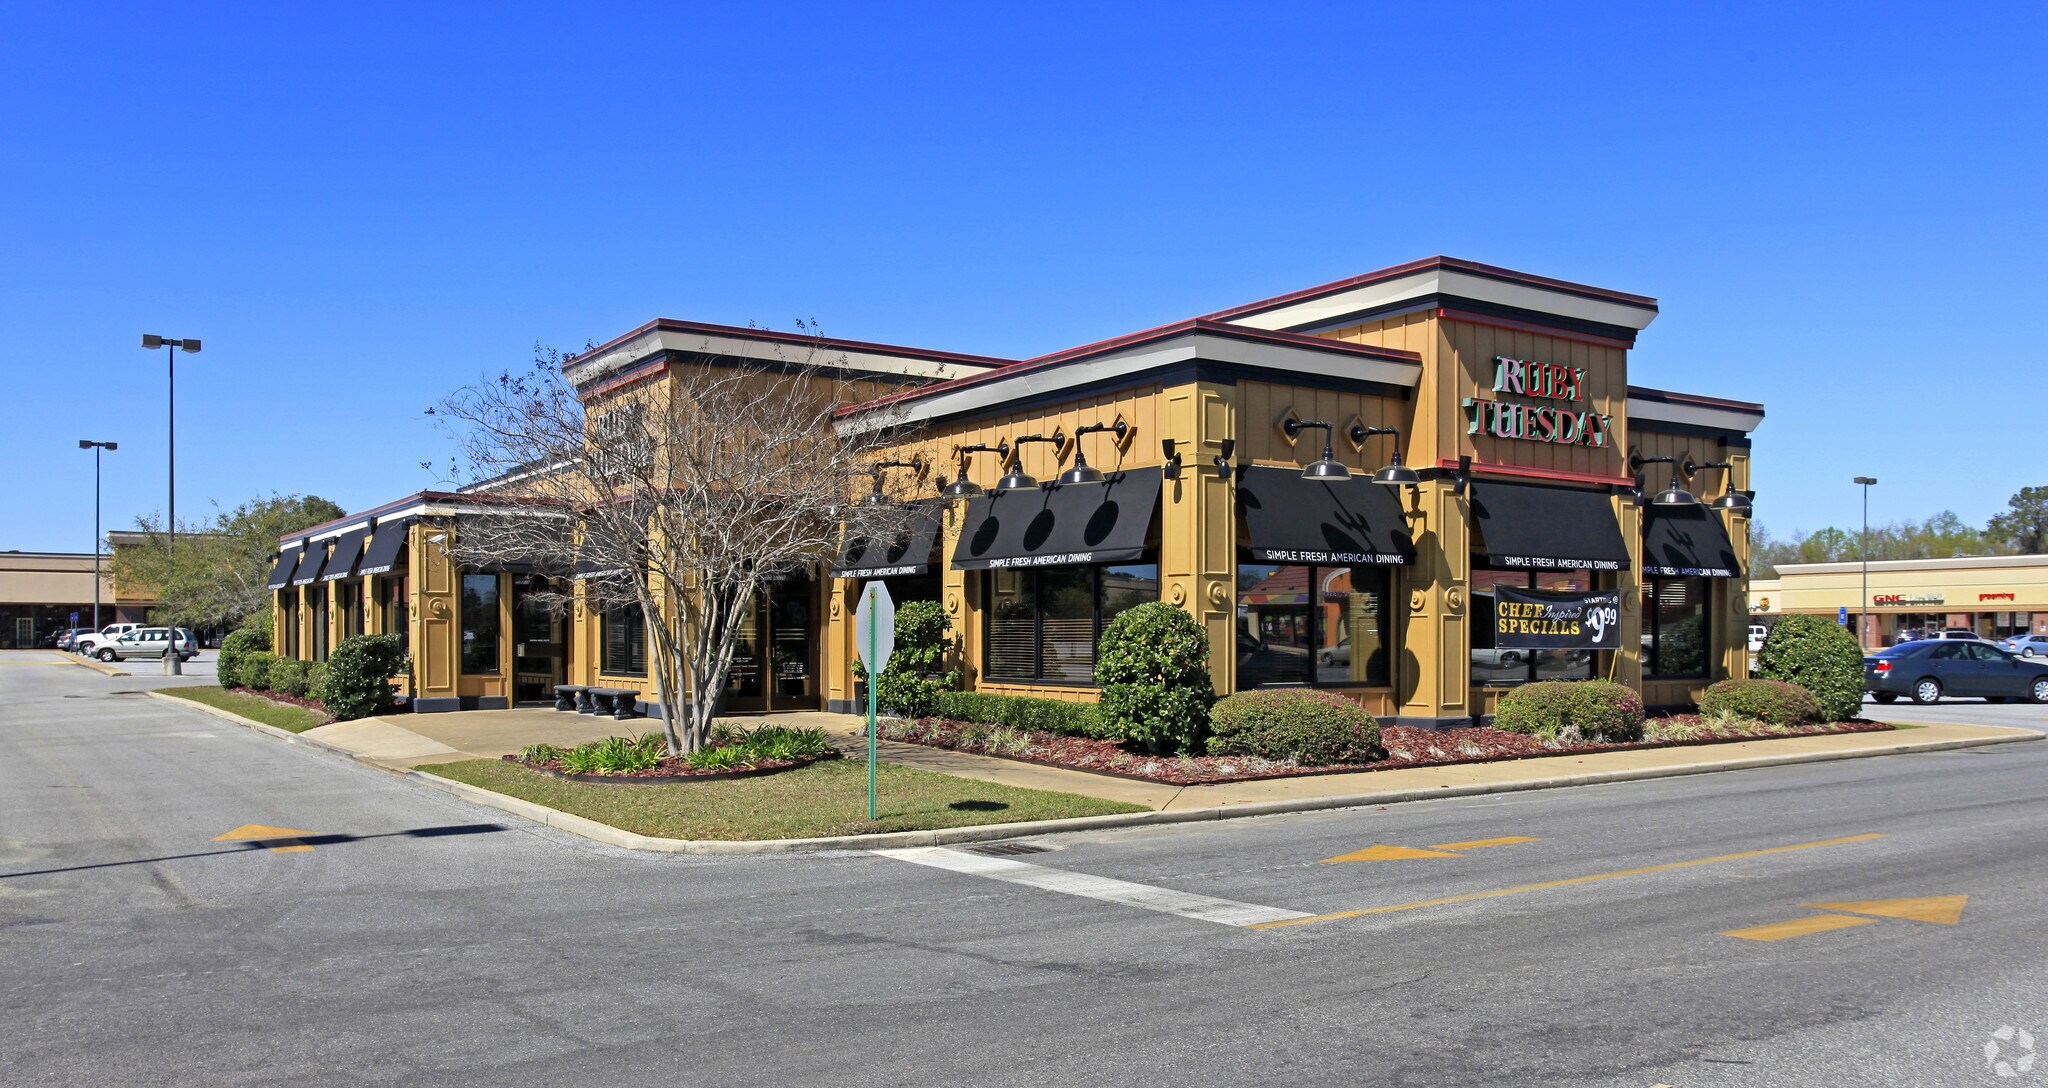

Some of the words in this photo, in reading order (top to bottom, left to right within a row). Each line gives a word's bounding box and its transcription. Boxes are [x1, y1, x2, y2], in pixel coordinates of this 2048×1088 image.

[1493, 356, 1587, 401] RUBY
[1464, 398, 1613, 448] TUESDAY
[989, 558, 1010, 568] SIMPLE
[1011, 556, 1031, 566] FRESH
[1032, 554, 1067, 565] AMERICAN
[1068, 552, 1092, 562] DINING
[1266, 550, 1297, 561] SIMPLE
[1300, 551, 1328, 562] FRESH
[1331, 553, 1374, 563] AMERICAN
[1376, 554, 1404, 564] DINING
[1505, 556, 1530, 566] SIMPLE
[1532, 557, 1555, 567] FRESH
[1557, 559, 1593, 569] AMERICAN
[1594, 560, 1618, 570] DINING
[840, 569, 858, 578] SIMPLE
[857, 568, 872, 576] FRESH
[873, 566, 898, 576] AMERICAN
[899, 565, 917, 574] DINING
[1642, 566, 1659, 575] MPLE
[1660, 567, 1679, 575] FRESH
[1681, 567, 1711, 577] AMERICAN
[1712, 568, 1732, 577] DINING
[1873, 594, 1906, 602] GNC
[1498, 602, 1545, 618] CHEF
[1540, 604, 1582, 624] Inspired
[1498, 618, 1581, 635] SPECIALS
